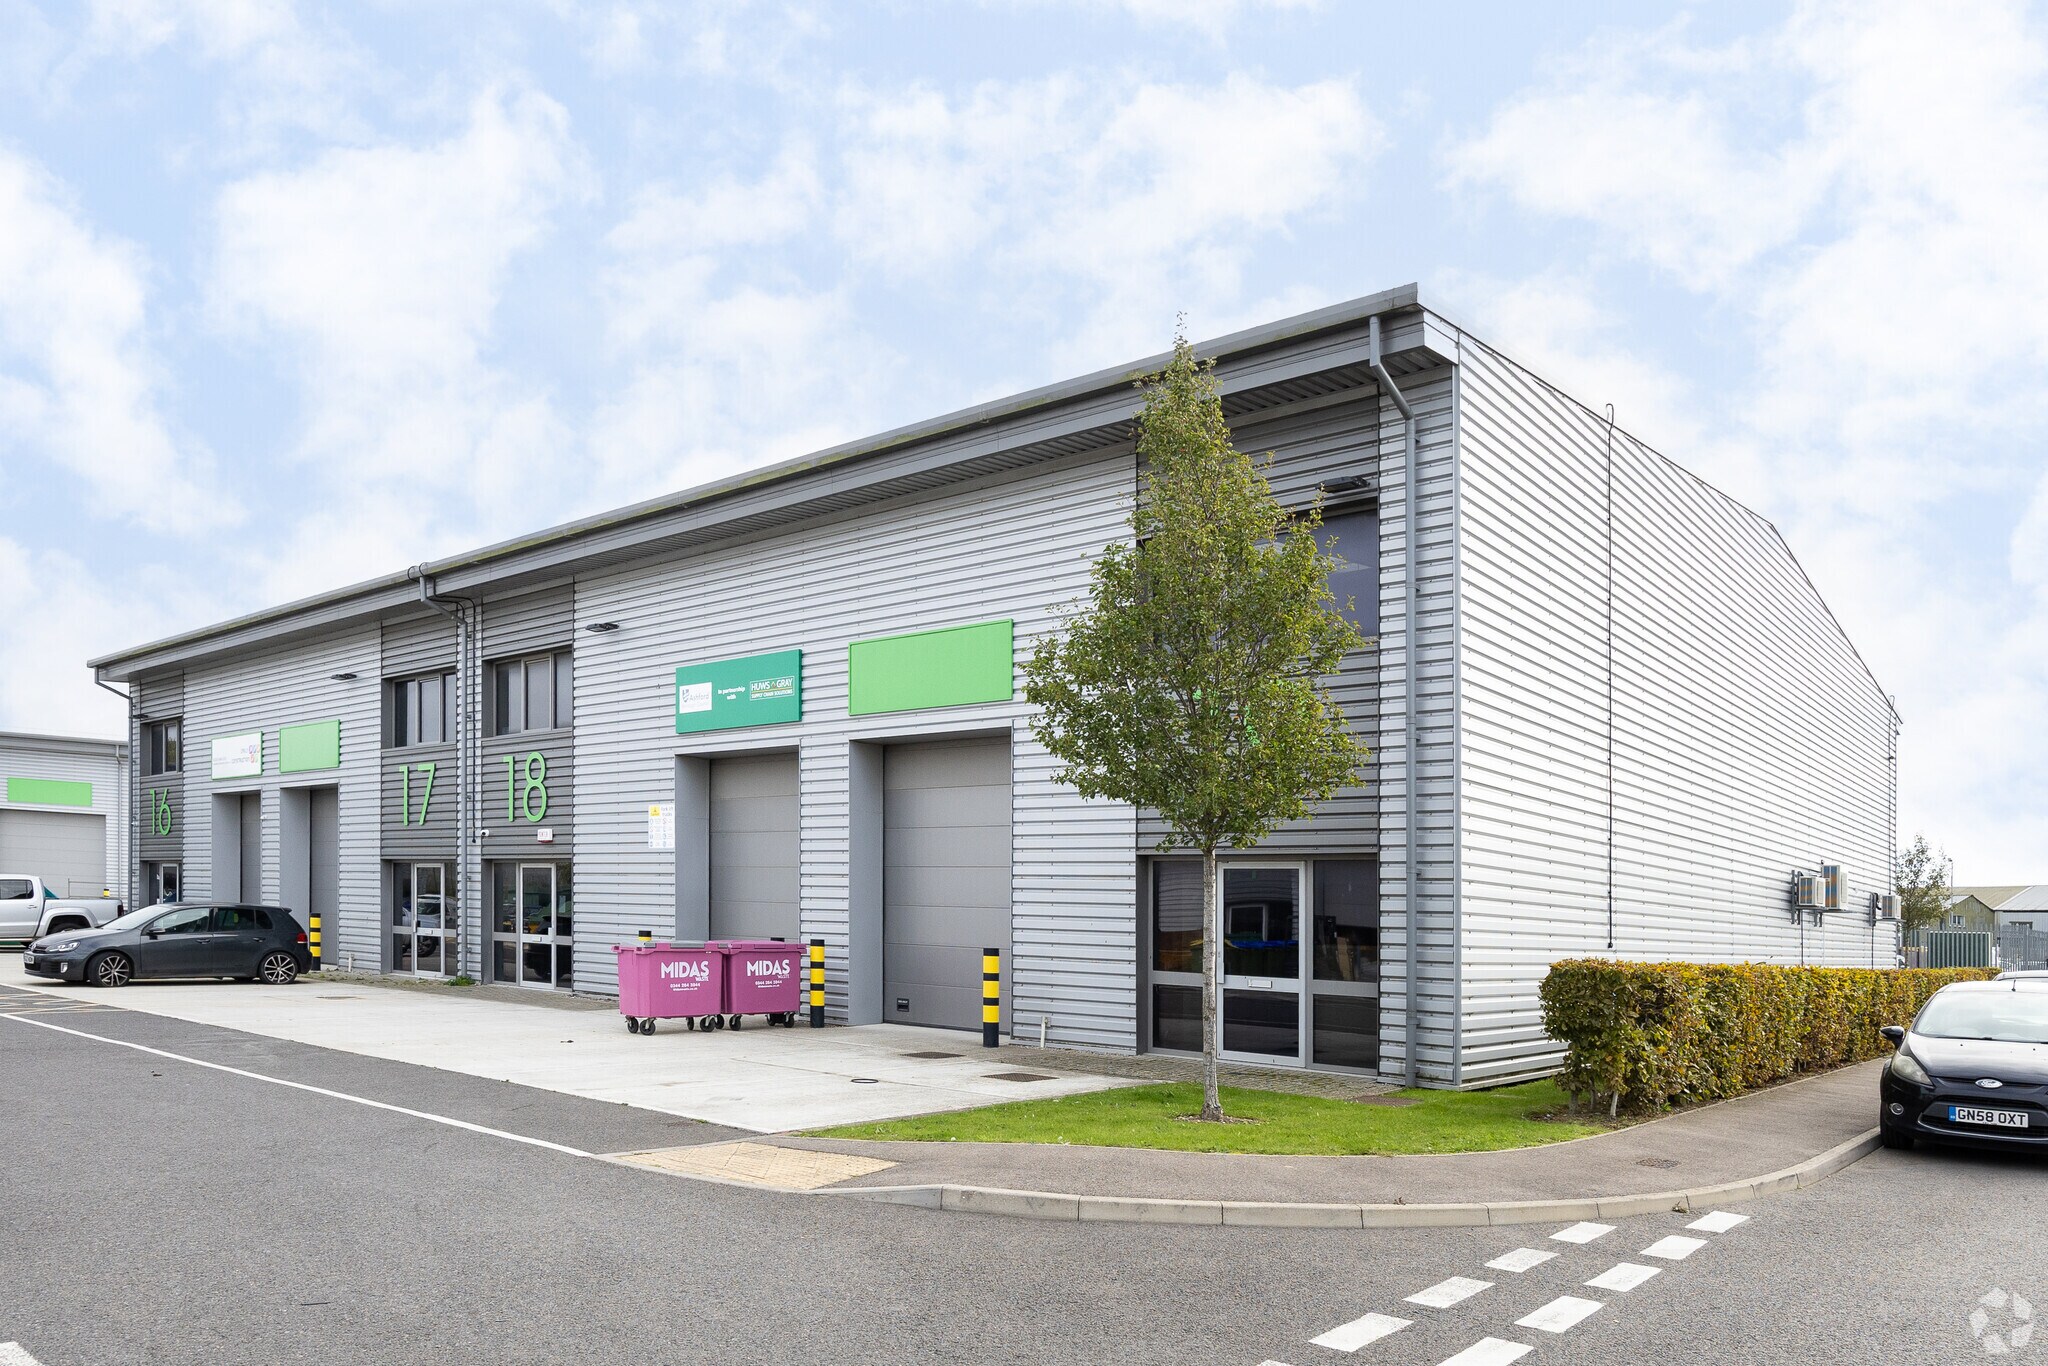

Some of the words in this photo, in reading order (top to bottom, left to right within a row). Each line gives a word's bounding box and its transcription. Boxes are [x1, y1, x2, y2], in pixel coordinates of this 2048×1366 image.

[751, 681, 770, 691] HUWS
[776, 678, 793, 688] GRAY
[399, 762, 436, 826] 17
[502, 752, 547, 822] 18
[150, 787, 171, 836] 16
[661, 961, 709, 978] MIDAS
[747, 960, 790, 976] MIDAS
[1958, 1109, 1994, 1122] GN58
[1998, 1112, 2026, 1126] OXT
